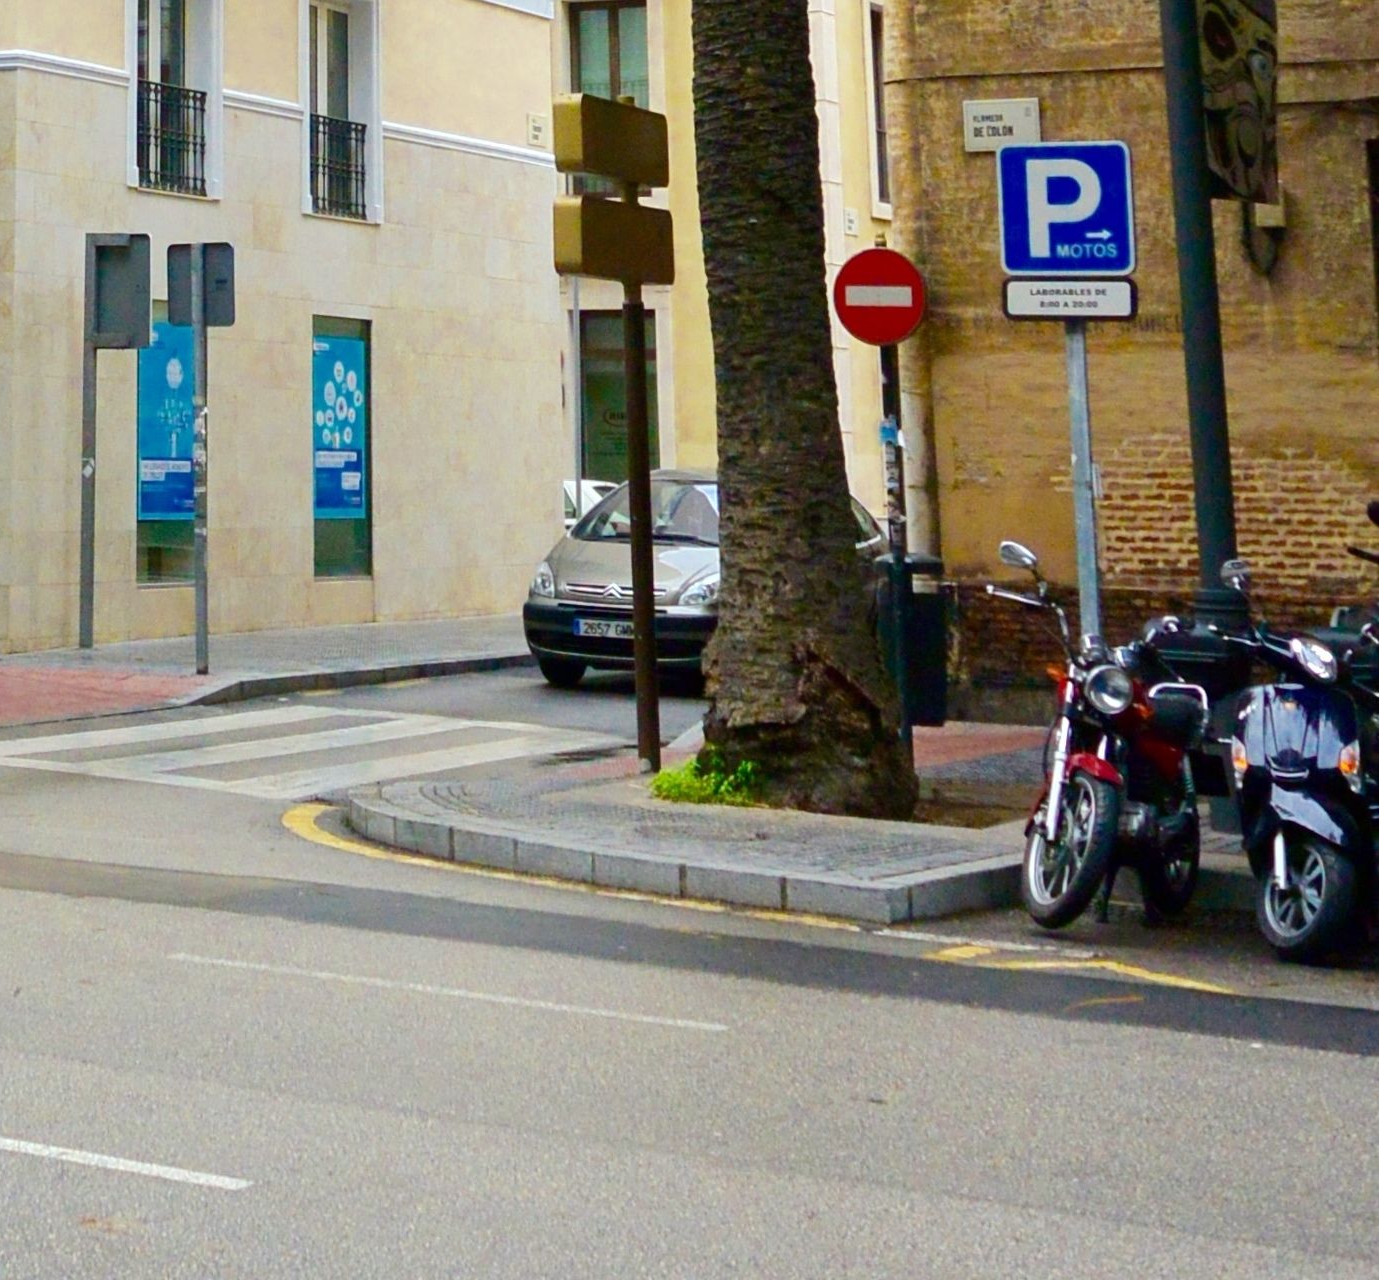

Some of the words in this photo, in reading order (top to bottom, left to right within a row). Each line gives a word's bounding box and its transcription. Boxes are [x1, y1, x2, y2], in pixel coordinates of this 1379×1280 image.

[973, 126, 984, 137] DE
[1025, 158, 1101, 258] P
[1056, 243, 1118, 258] MOTOS
[1029, 288, 1092, 296] LABORABLES
[1095, 288, 1108, 296] DE
[583, 622, 611, 635] 2657
